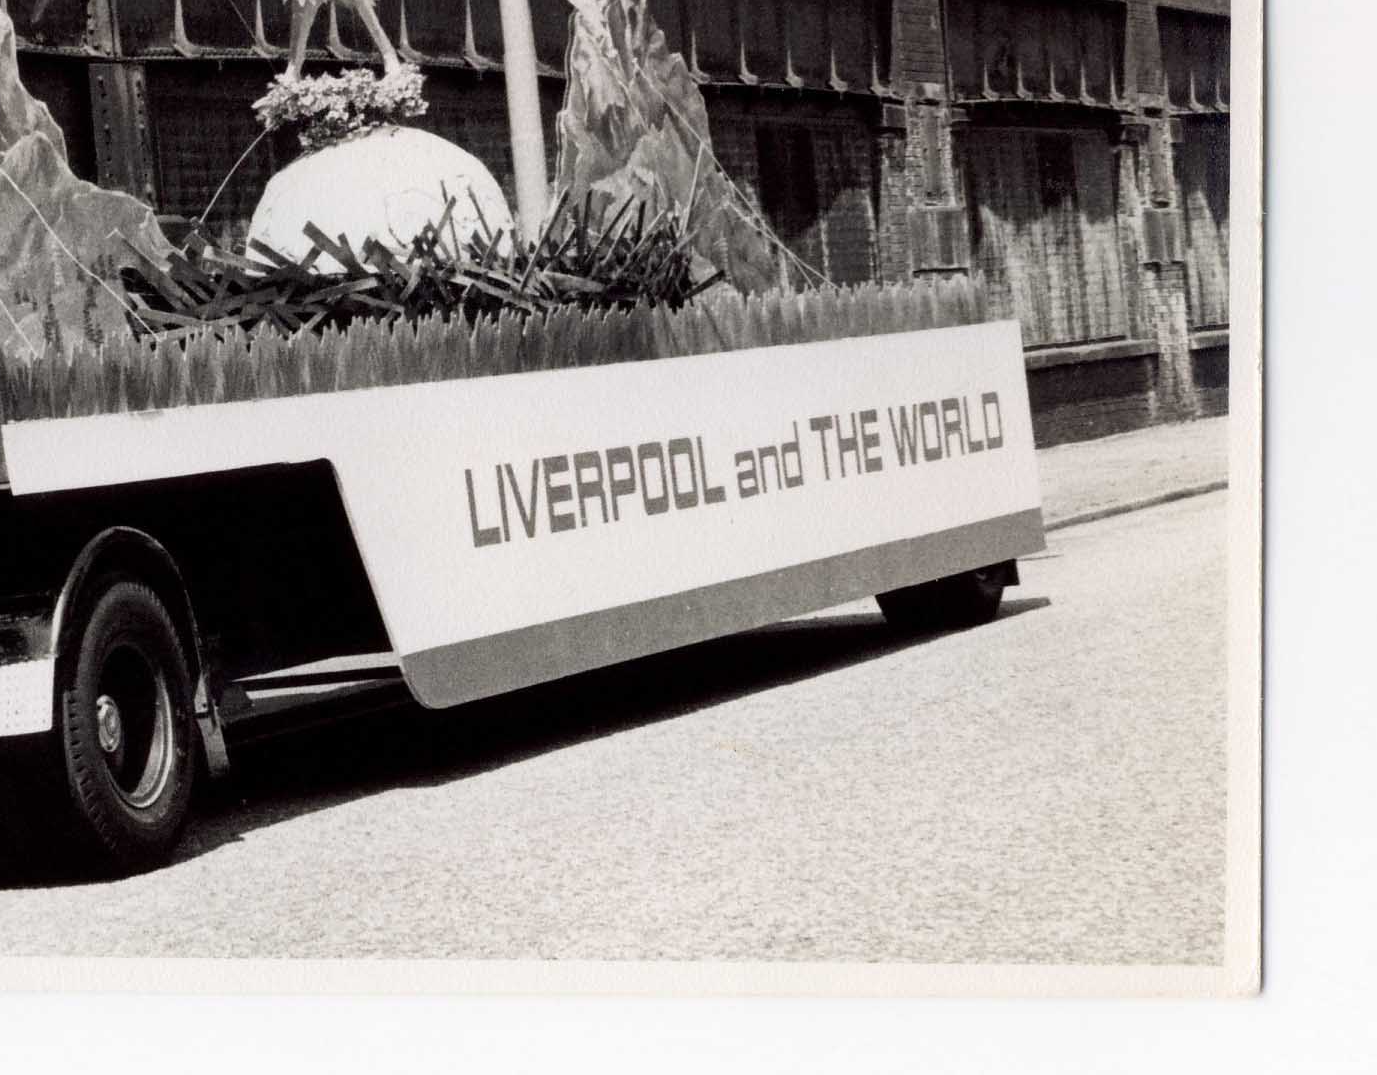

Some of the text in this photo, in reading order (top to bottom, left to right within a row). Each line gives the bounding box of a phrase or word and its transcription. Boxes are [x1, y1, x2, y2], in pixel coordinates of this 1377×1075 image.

[465, 391, 1004, 548] LIVERPOOL and THE WORLD
